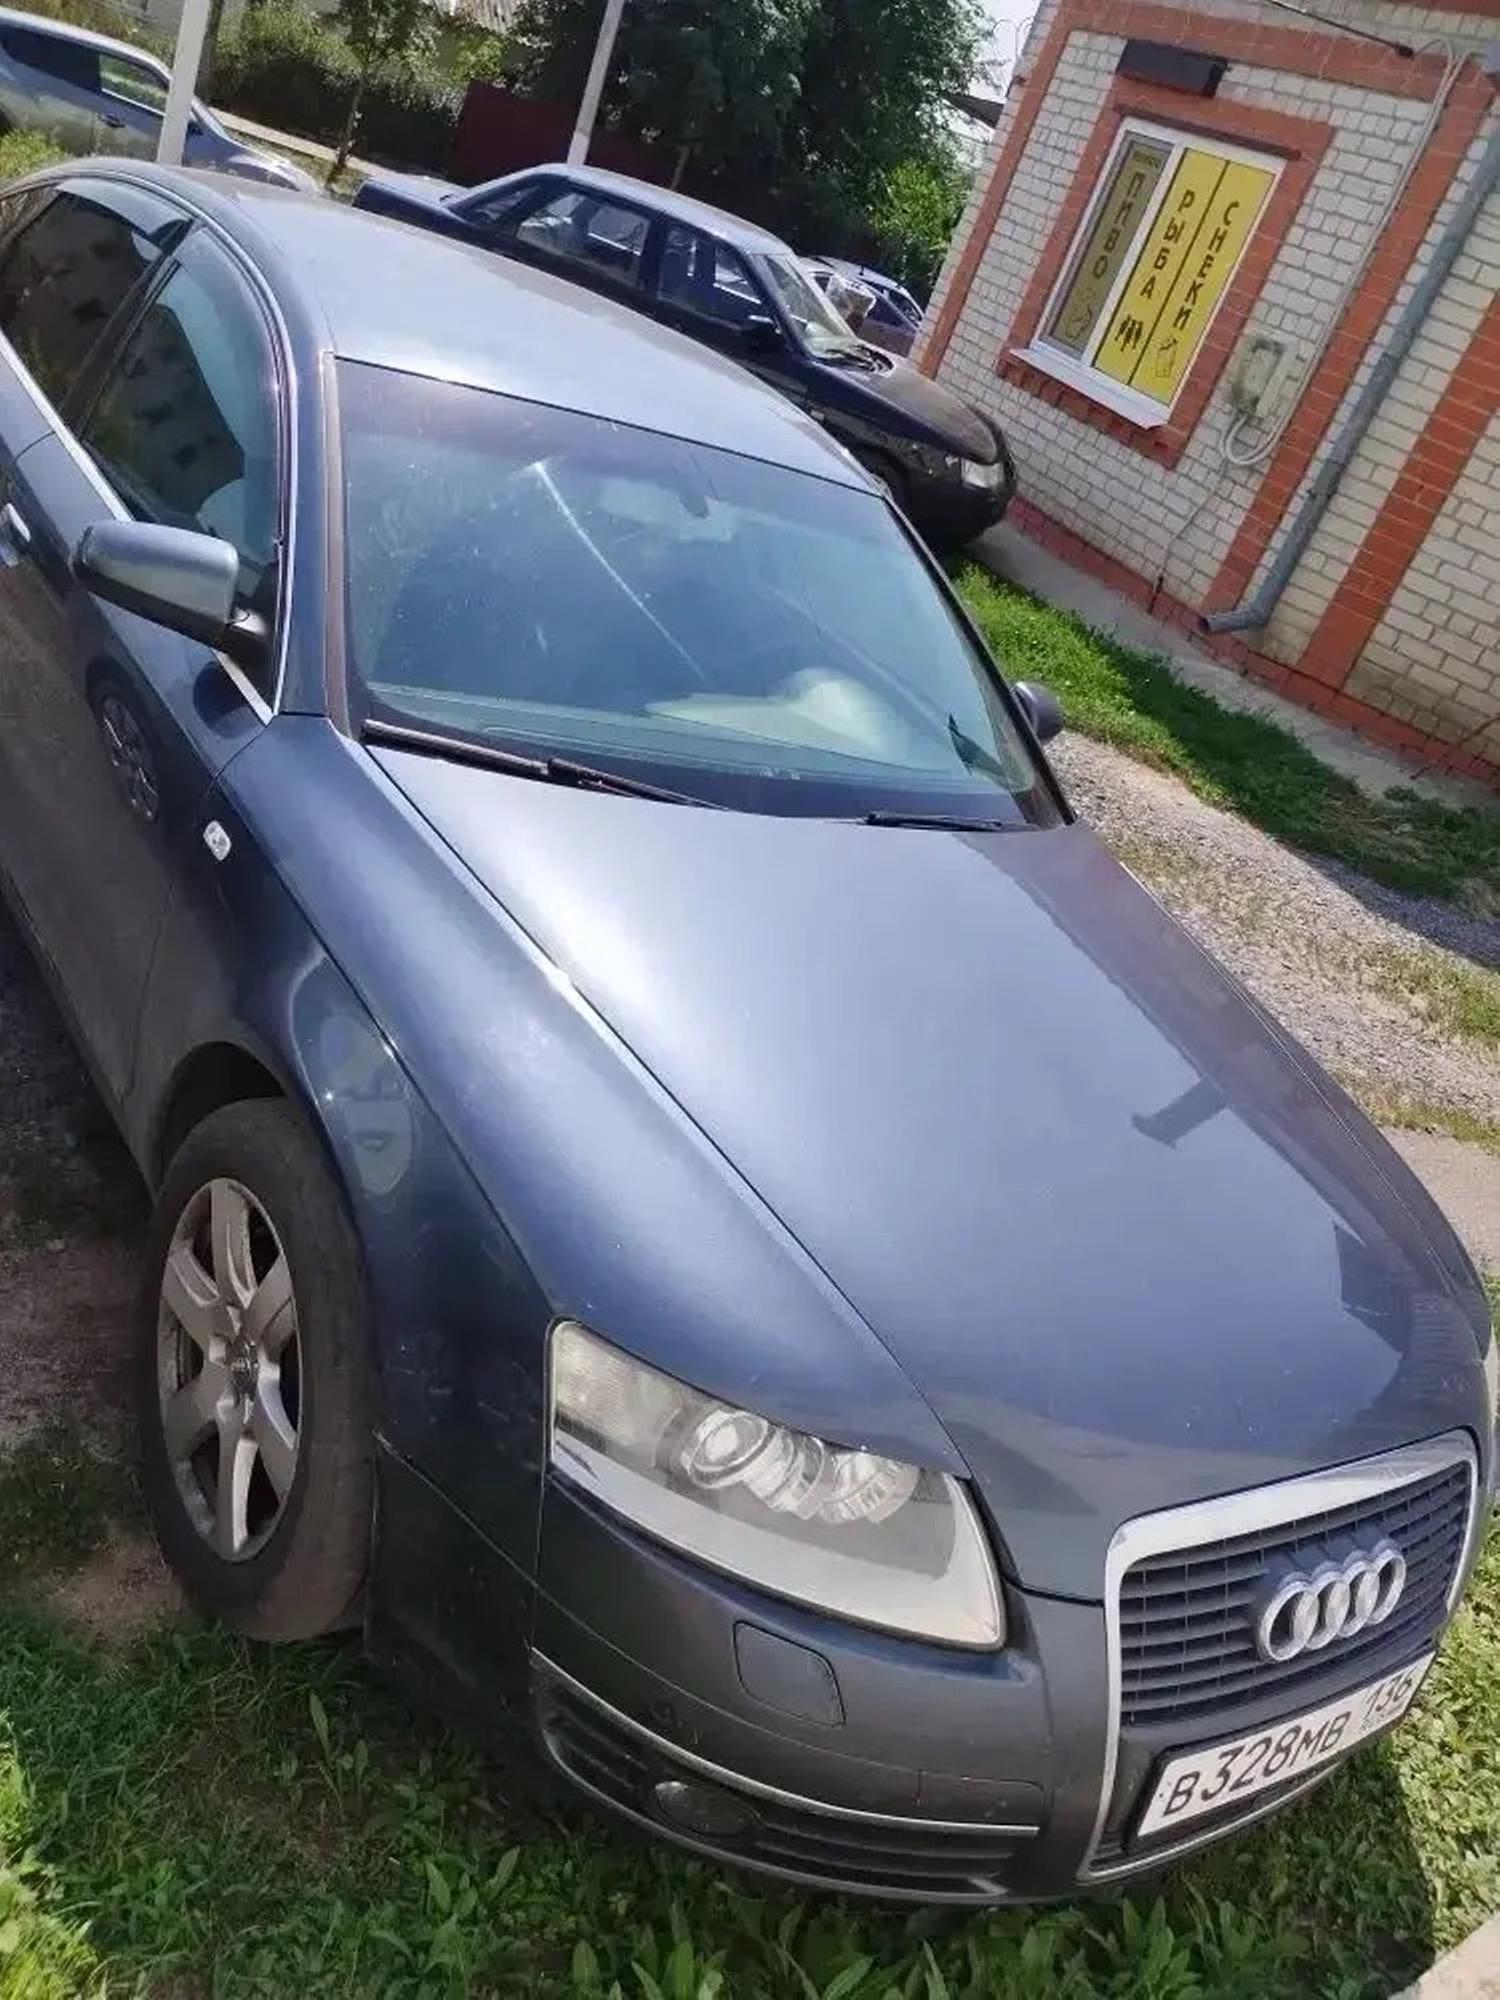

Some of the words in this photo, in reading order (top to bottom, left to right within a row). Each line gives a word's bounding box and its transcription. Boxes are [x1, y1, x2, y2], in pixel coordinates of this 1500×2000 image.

[1093, 173, 1146, 278] ПИВО
[1140, 190, 1195, 300] РЫБА
[1172, 201, 1240, 331] СНЕКИ
